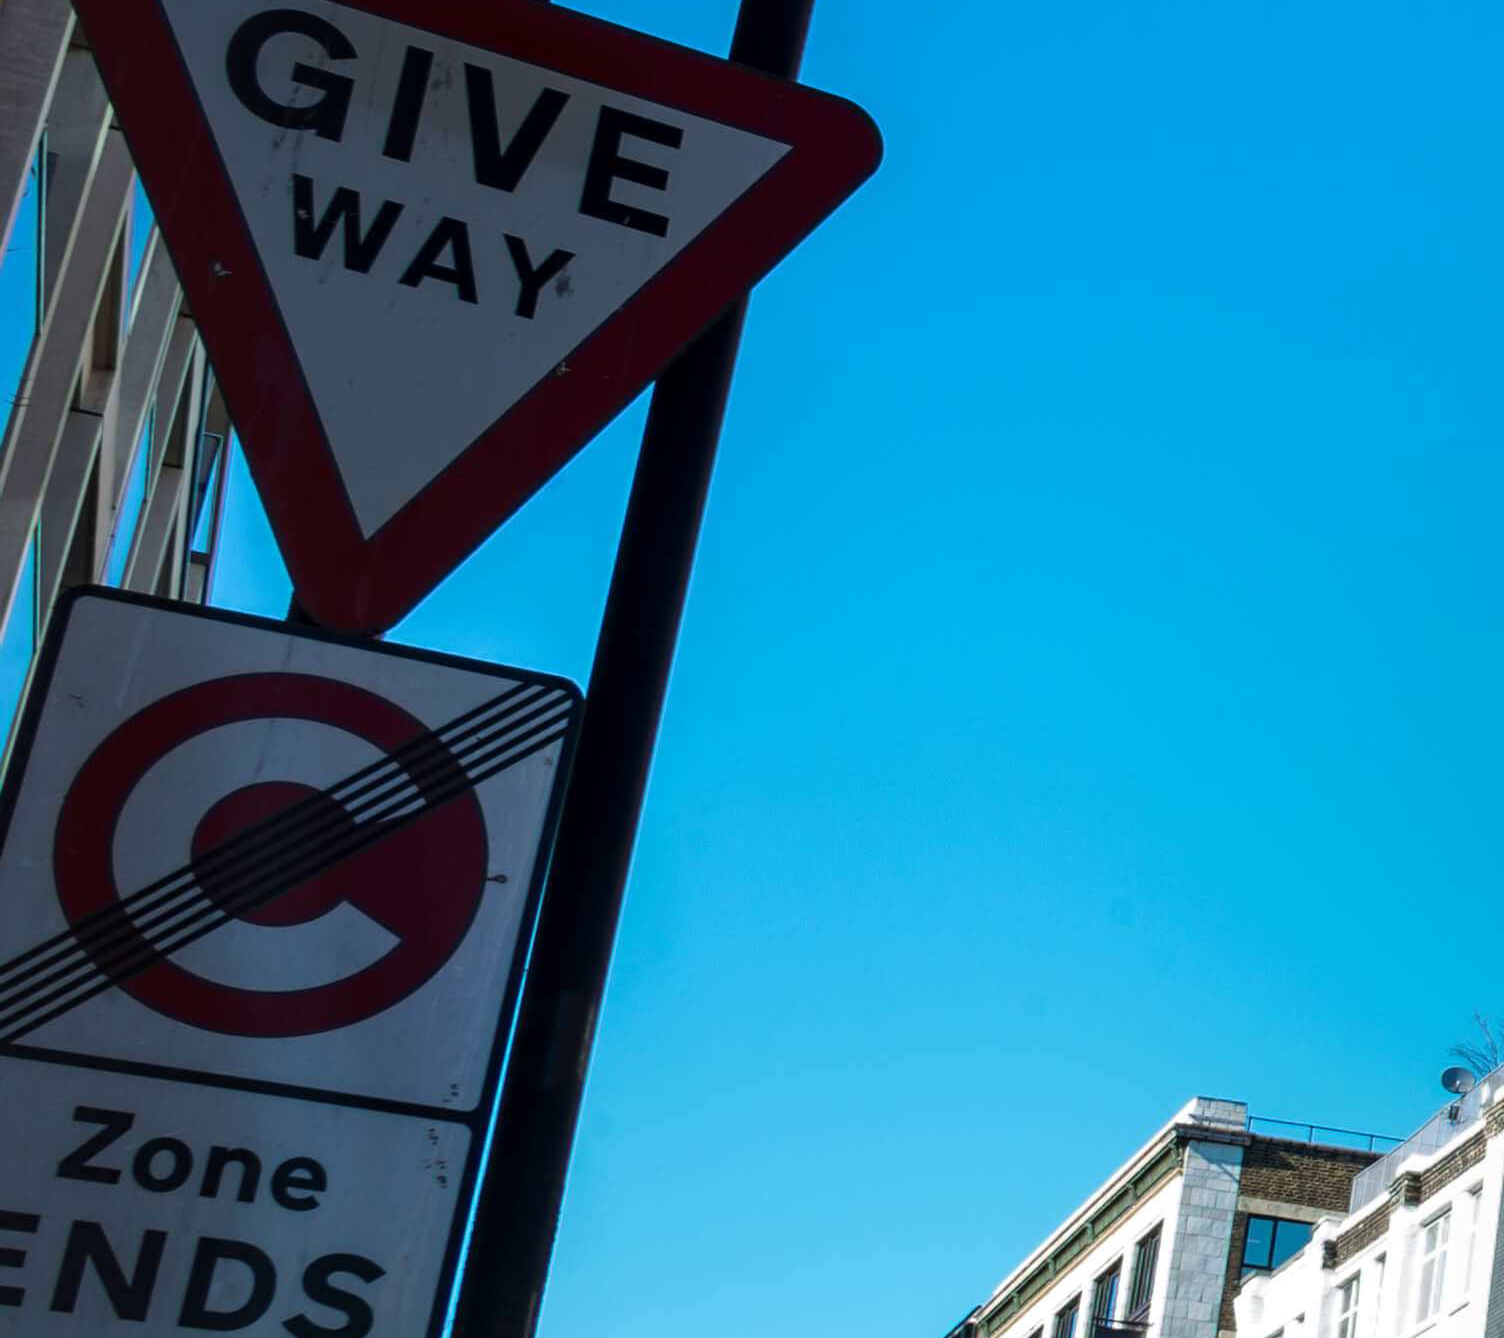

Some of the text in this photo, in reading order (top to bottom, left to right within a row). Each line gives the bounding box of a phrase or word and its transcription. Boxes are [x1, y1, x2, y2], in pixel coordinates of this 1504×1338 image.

[225, 8, 684, 238] GIVE
[292, 174, 576, 320] WAY
[56, 1106, 328, 1211] Zone
